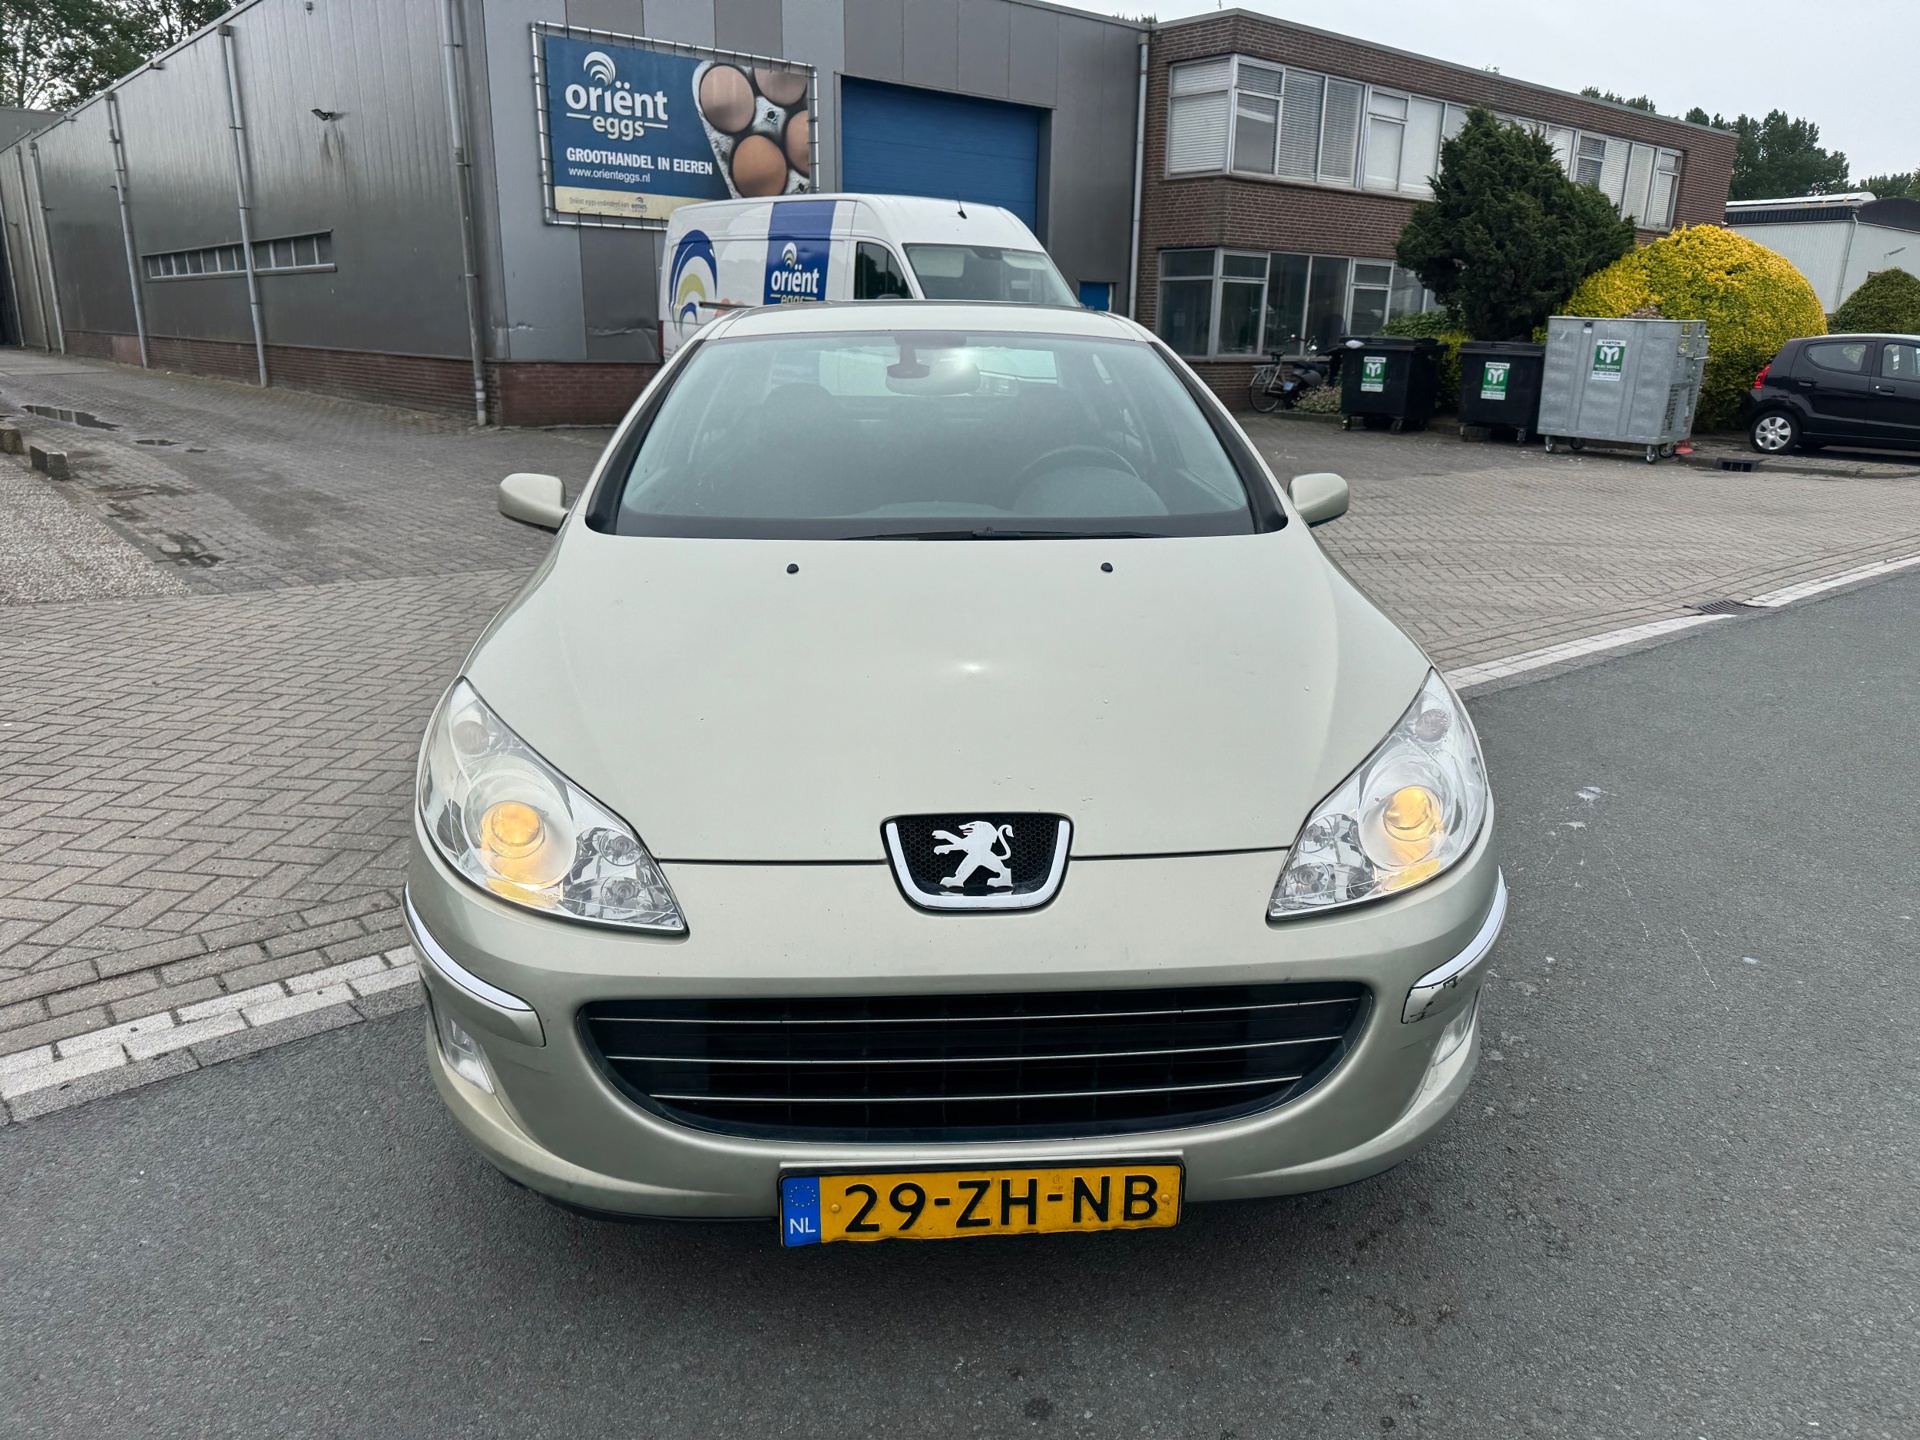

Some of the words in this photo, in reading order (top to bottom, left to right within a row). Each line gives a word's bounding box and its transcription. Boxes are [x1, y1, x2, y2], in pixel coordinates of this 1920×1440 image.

[565, 81, 668, 120] oriënt
[593, 116, 645, 141] eggs
[566, 147, 655, 169] GROOTHANDEL
[658, 157, 670, 170] IN
[673, 159, 713, 175] EIEREN
[568, 168, 651, 183] www.orienteggs.nl
[771, 263, 820, 294] oriënt
[844, 1175, 1159, 1233] 29-ZH-NB
[790, 1217, 816, 1234] NL
